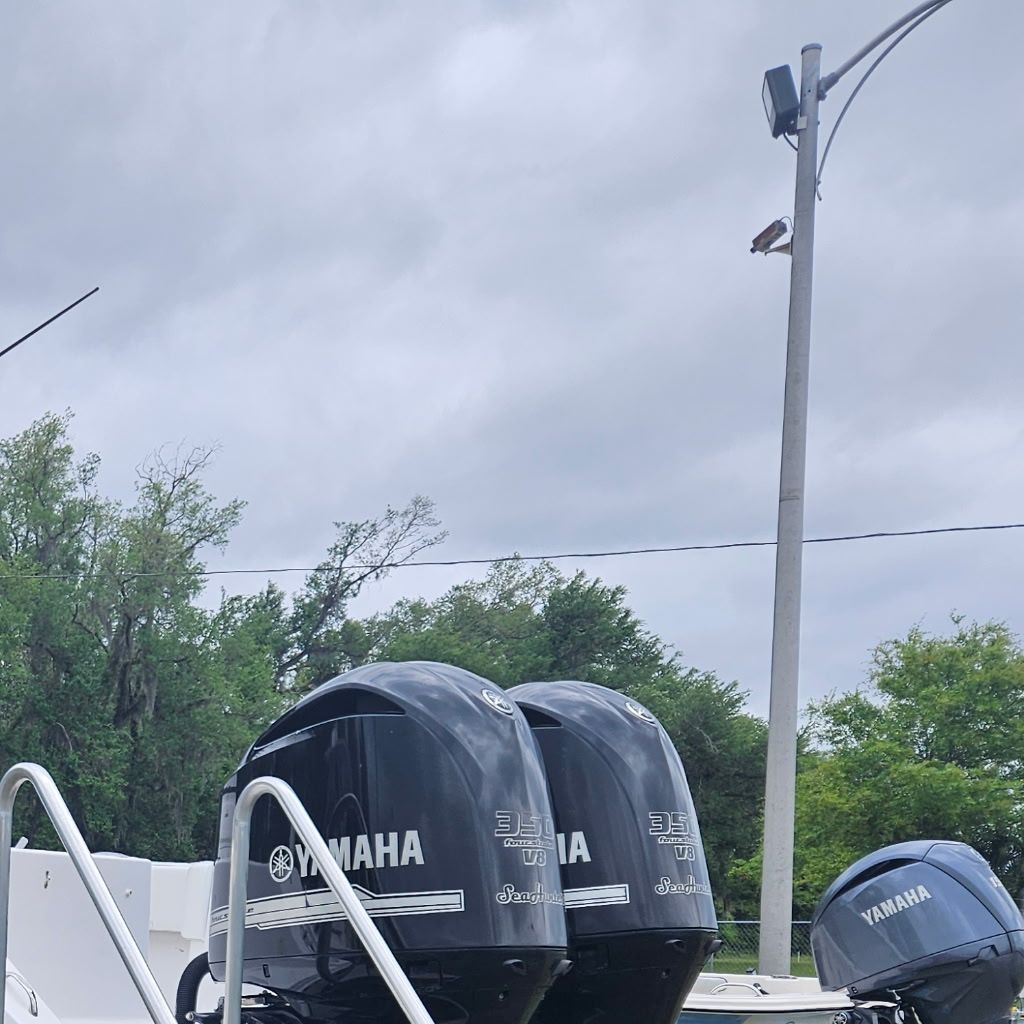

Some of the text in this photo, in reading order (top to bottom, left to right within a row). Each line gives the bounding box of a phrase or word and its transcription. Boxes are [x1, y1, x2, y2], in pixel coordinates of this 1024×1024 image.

[295, 830, 425, 878] YMAHA
[522, 849, 547, 866] V8
[675, 845, 695, 861] V8
[860, 884, 933, 926] YAMAHA
